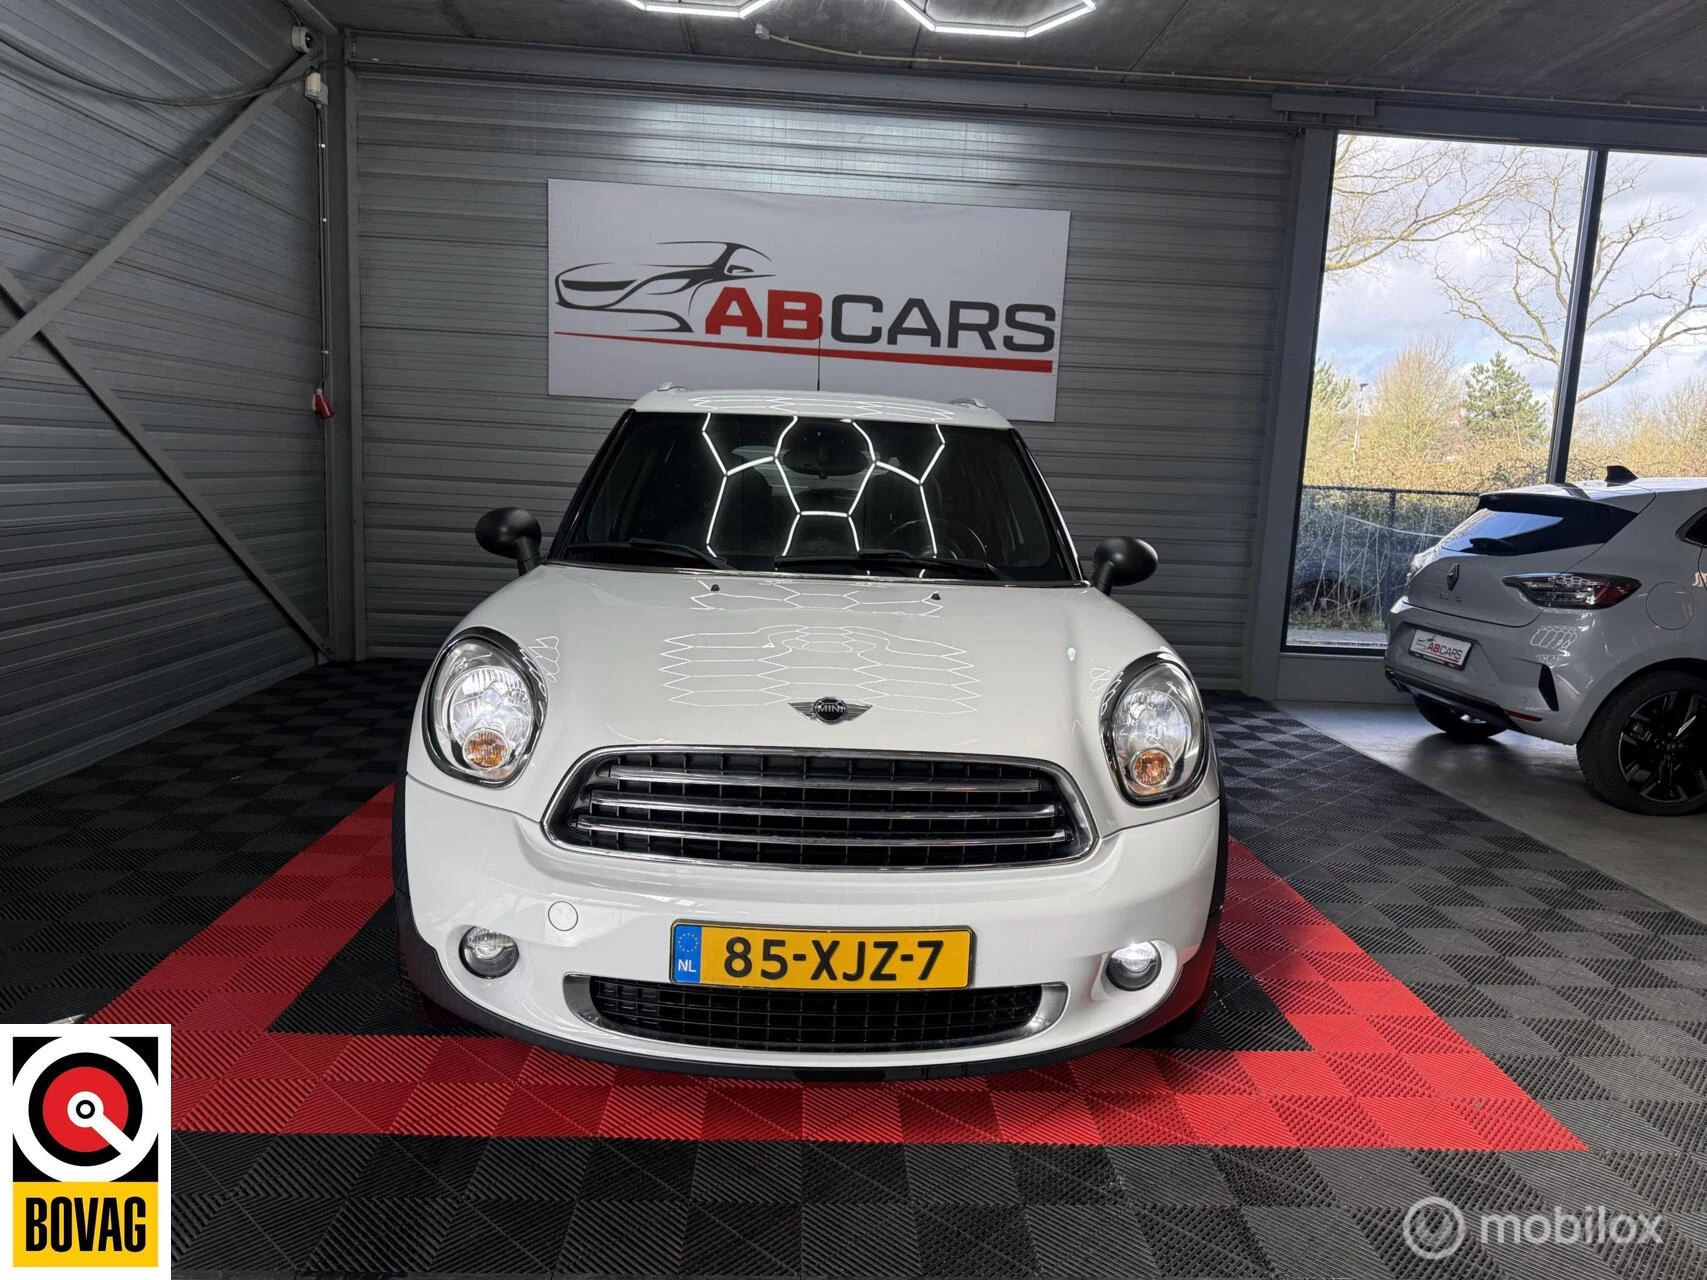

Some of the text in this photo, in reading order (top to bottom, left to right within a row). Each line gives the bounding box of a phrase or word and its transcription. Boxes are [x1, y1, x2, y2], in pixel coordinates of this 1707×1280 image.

[704, 286, 1056, 353] ABCARS
[1427, 642, 1463, 660] ABCARS
[817, 704, 844, 713] MINI
[678, 958, 697, 973] NL
[723, 936, 944, 981] 85-XJZ-7
